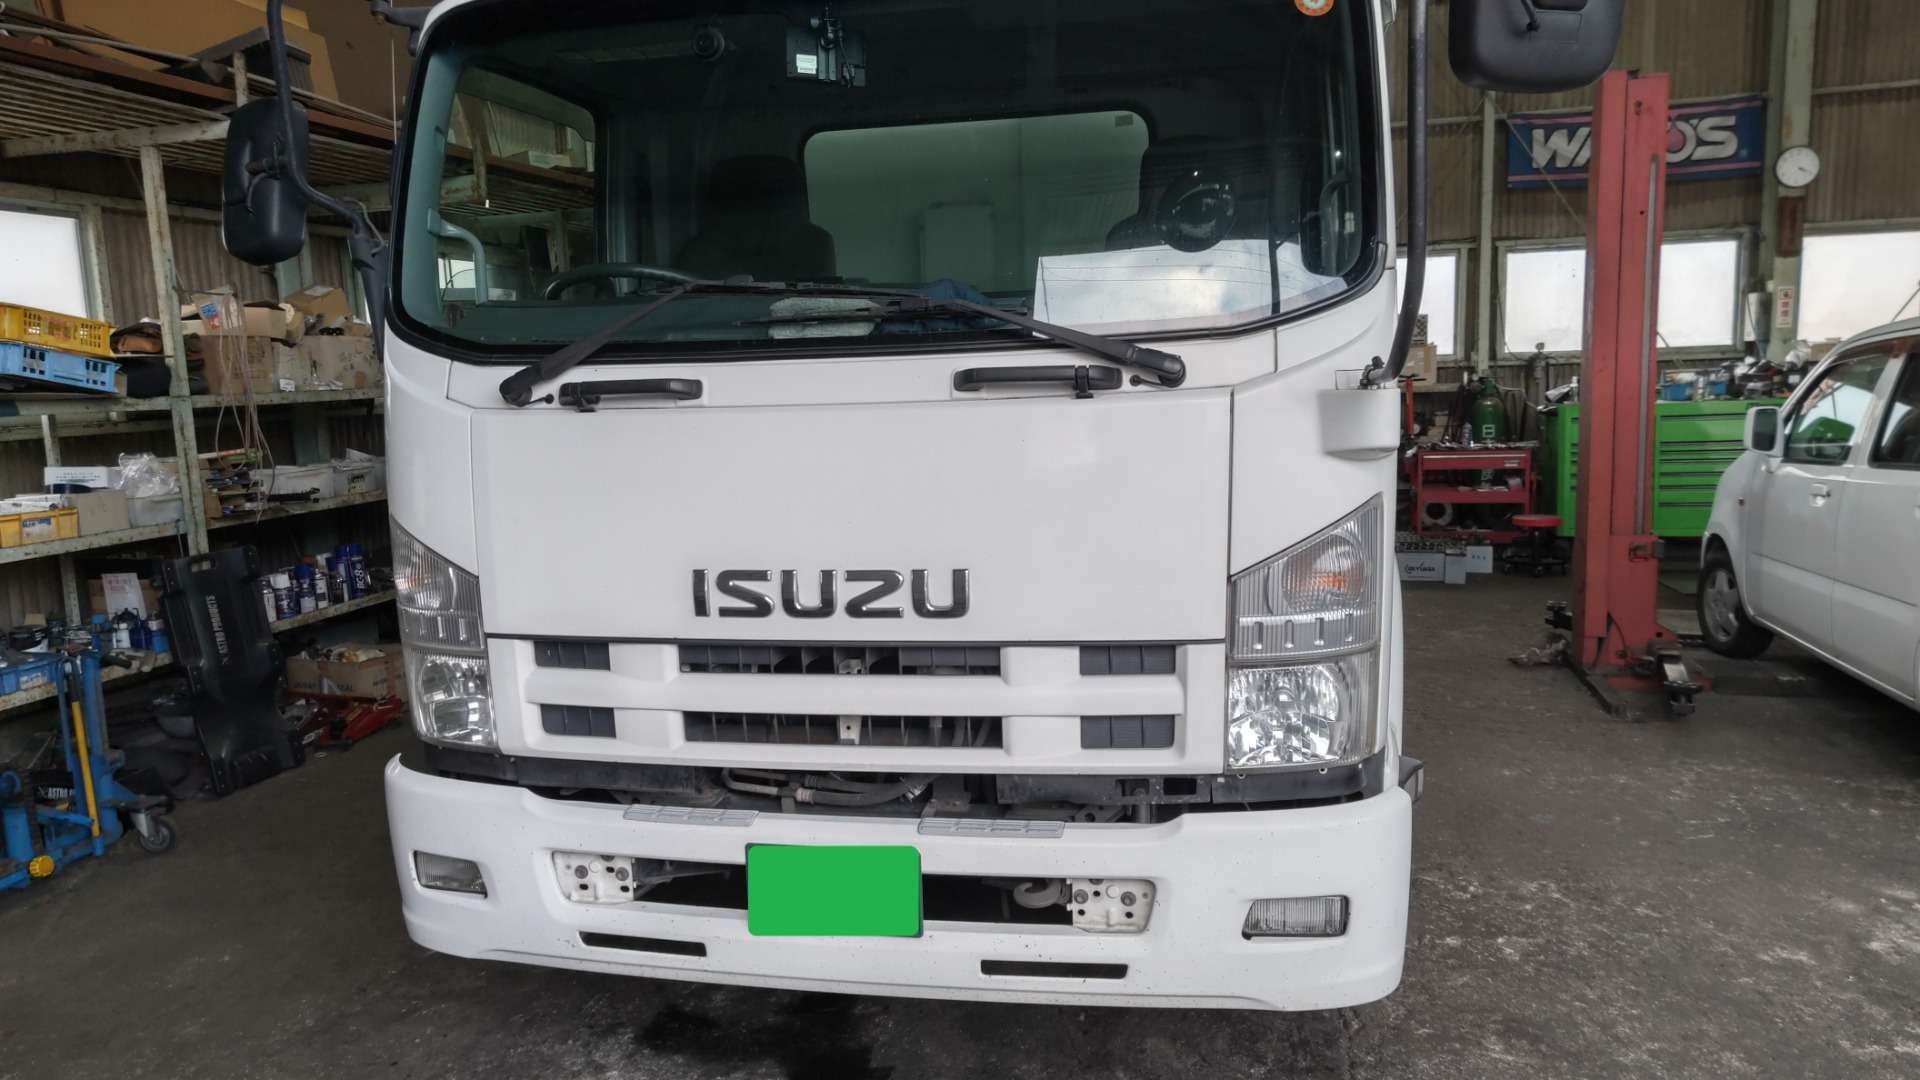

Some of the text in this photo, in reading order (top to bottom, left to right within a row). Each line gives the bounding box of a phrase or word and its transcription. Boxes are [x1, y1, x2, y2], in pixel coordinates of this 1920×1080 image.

[1531, 115, 1739, 169] WO'S
[206, 594, 223, 631] PRODUCTS
[692, 568, 970, 619] ISUZU
